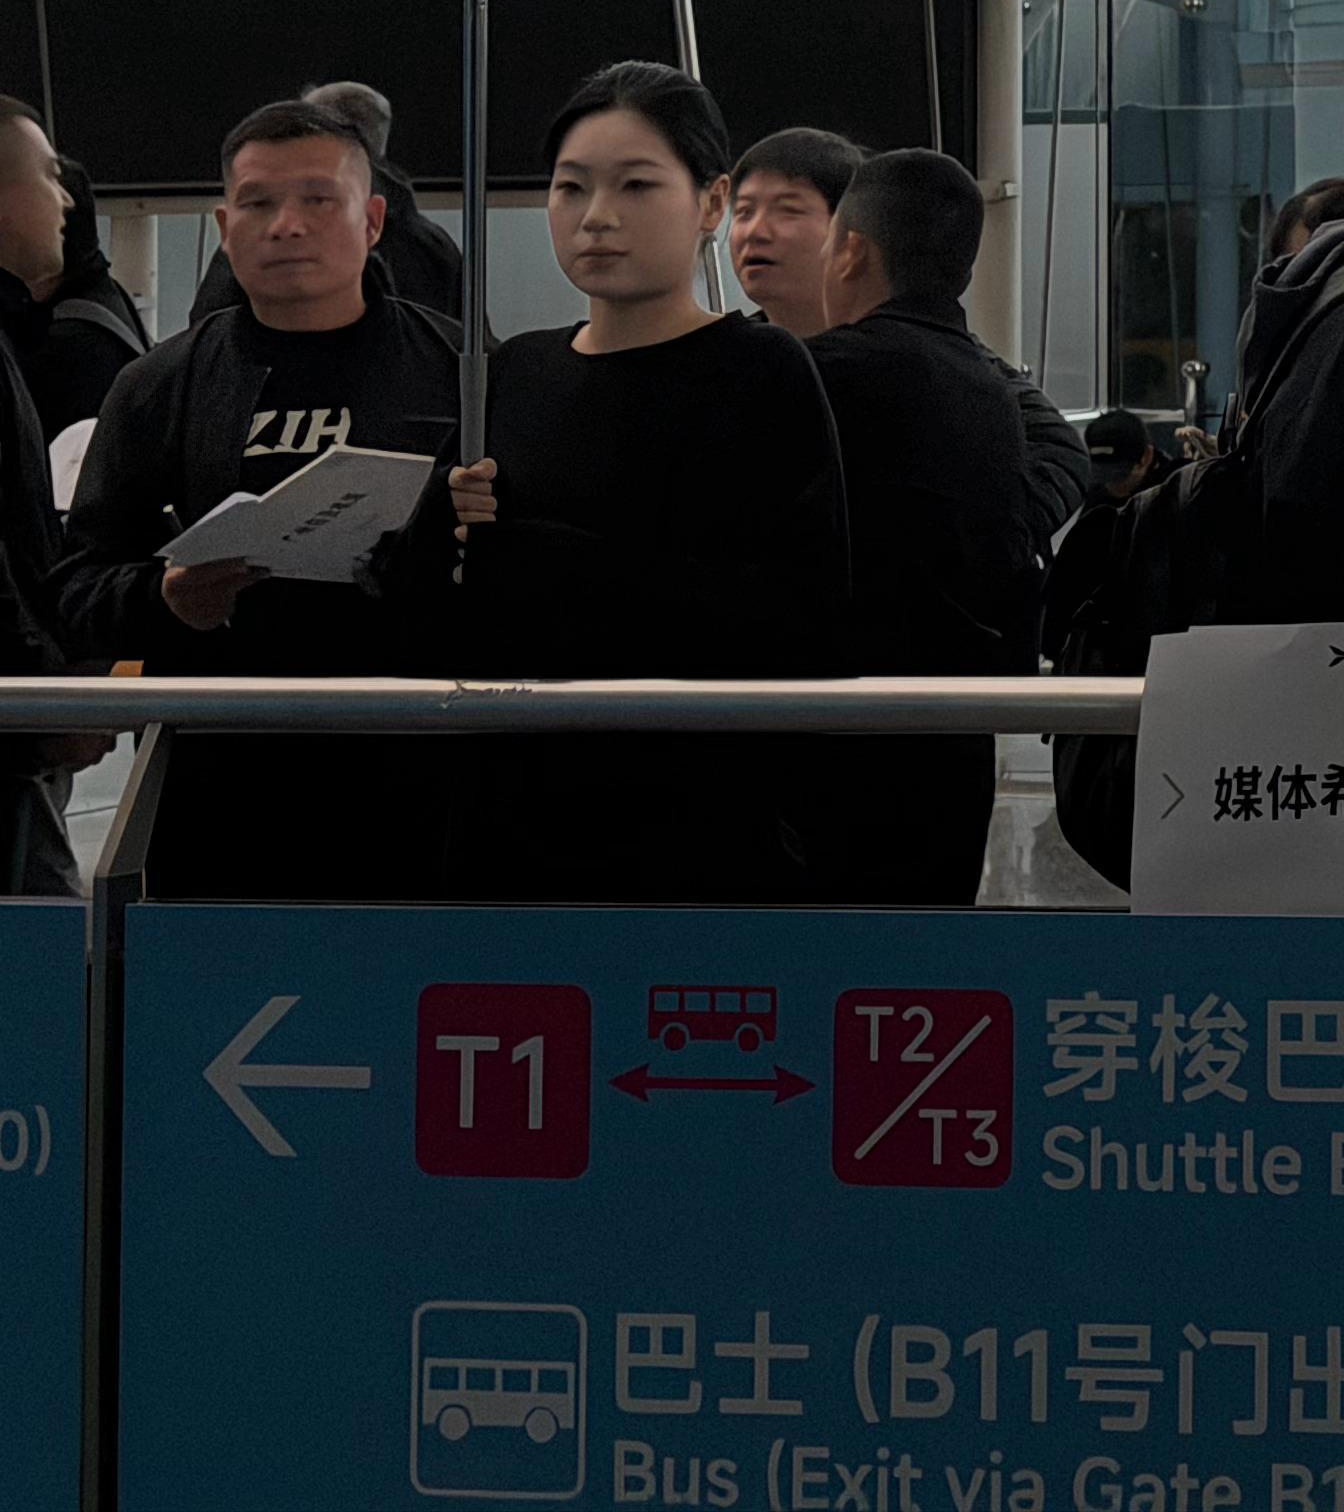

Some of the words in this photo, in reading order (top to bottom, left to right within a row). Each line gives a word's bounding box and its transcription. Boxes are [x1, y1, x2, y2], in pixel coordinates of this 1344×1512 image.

[855, 1005, 935, 1062] T2
[435, 1035, 544, 1130] T1
[919, 1108, 999, 1167] T3
[1042, 1125, 1302, 1195] Shuttle
[615, 1311, 810, 1416] 巴士
[614, 1439, 739, 1507] Bus
[767, 1438, 923, 1512] (Exit
[945, 1450, 1045, 1512] via
[1073, 1456, 1241, 1512] Gate
